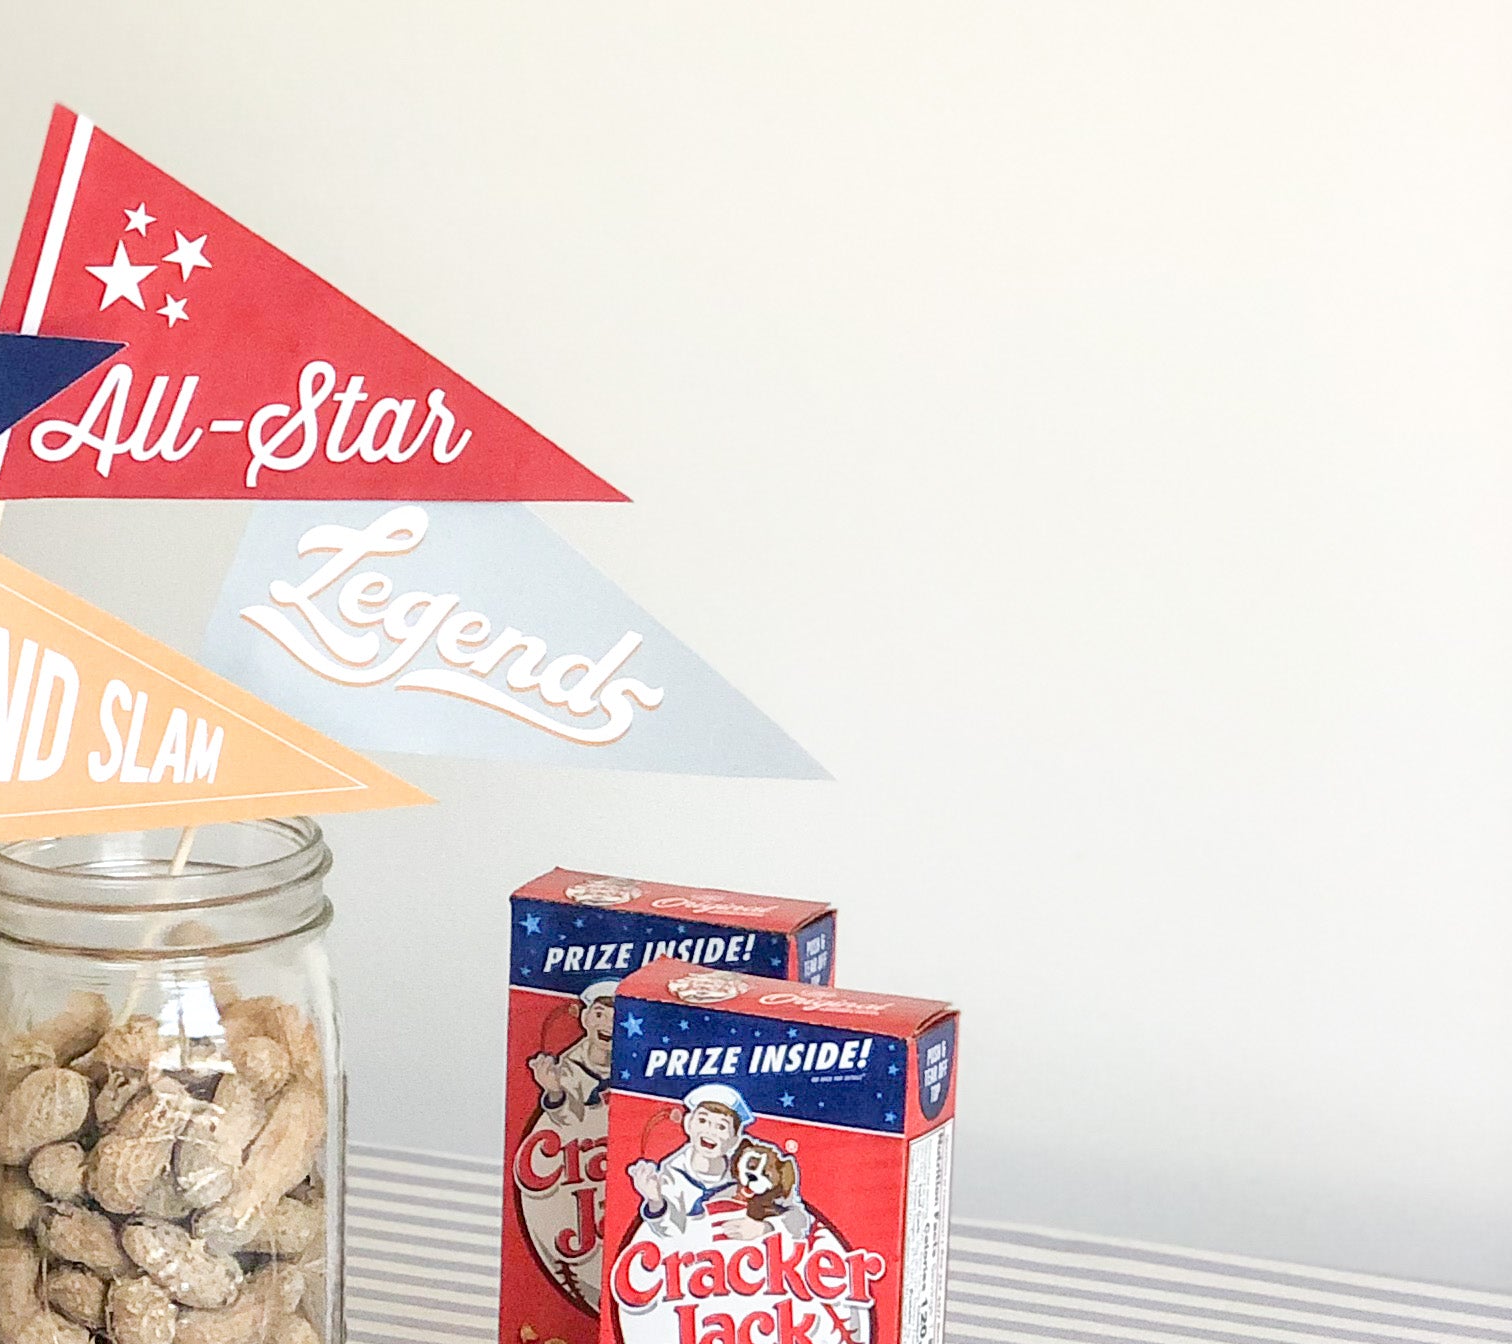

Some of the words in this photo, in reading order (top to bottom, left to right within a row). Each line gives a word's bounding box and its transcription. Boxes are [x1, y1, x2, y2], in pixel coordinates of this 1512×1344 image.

[29, 360, 473, 488] All-Star
[239, 505, 665, 747] Legends
[88, 679, 225, 784] SLAM
[543, 943, 634, 973] PRIZE
[641, 934, 755, 967] INSIDE!
[644, 1046, 737, 1077] PRIZE
[749, 1038, 872, 1073] INSIDE!
[614, 1233, 883, 1307] Cracker
